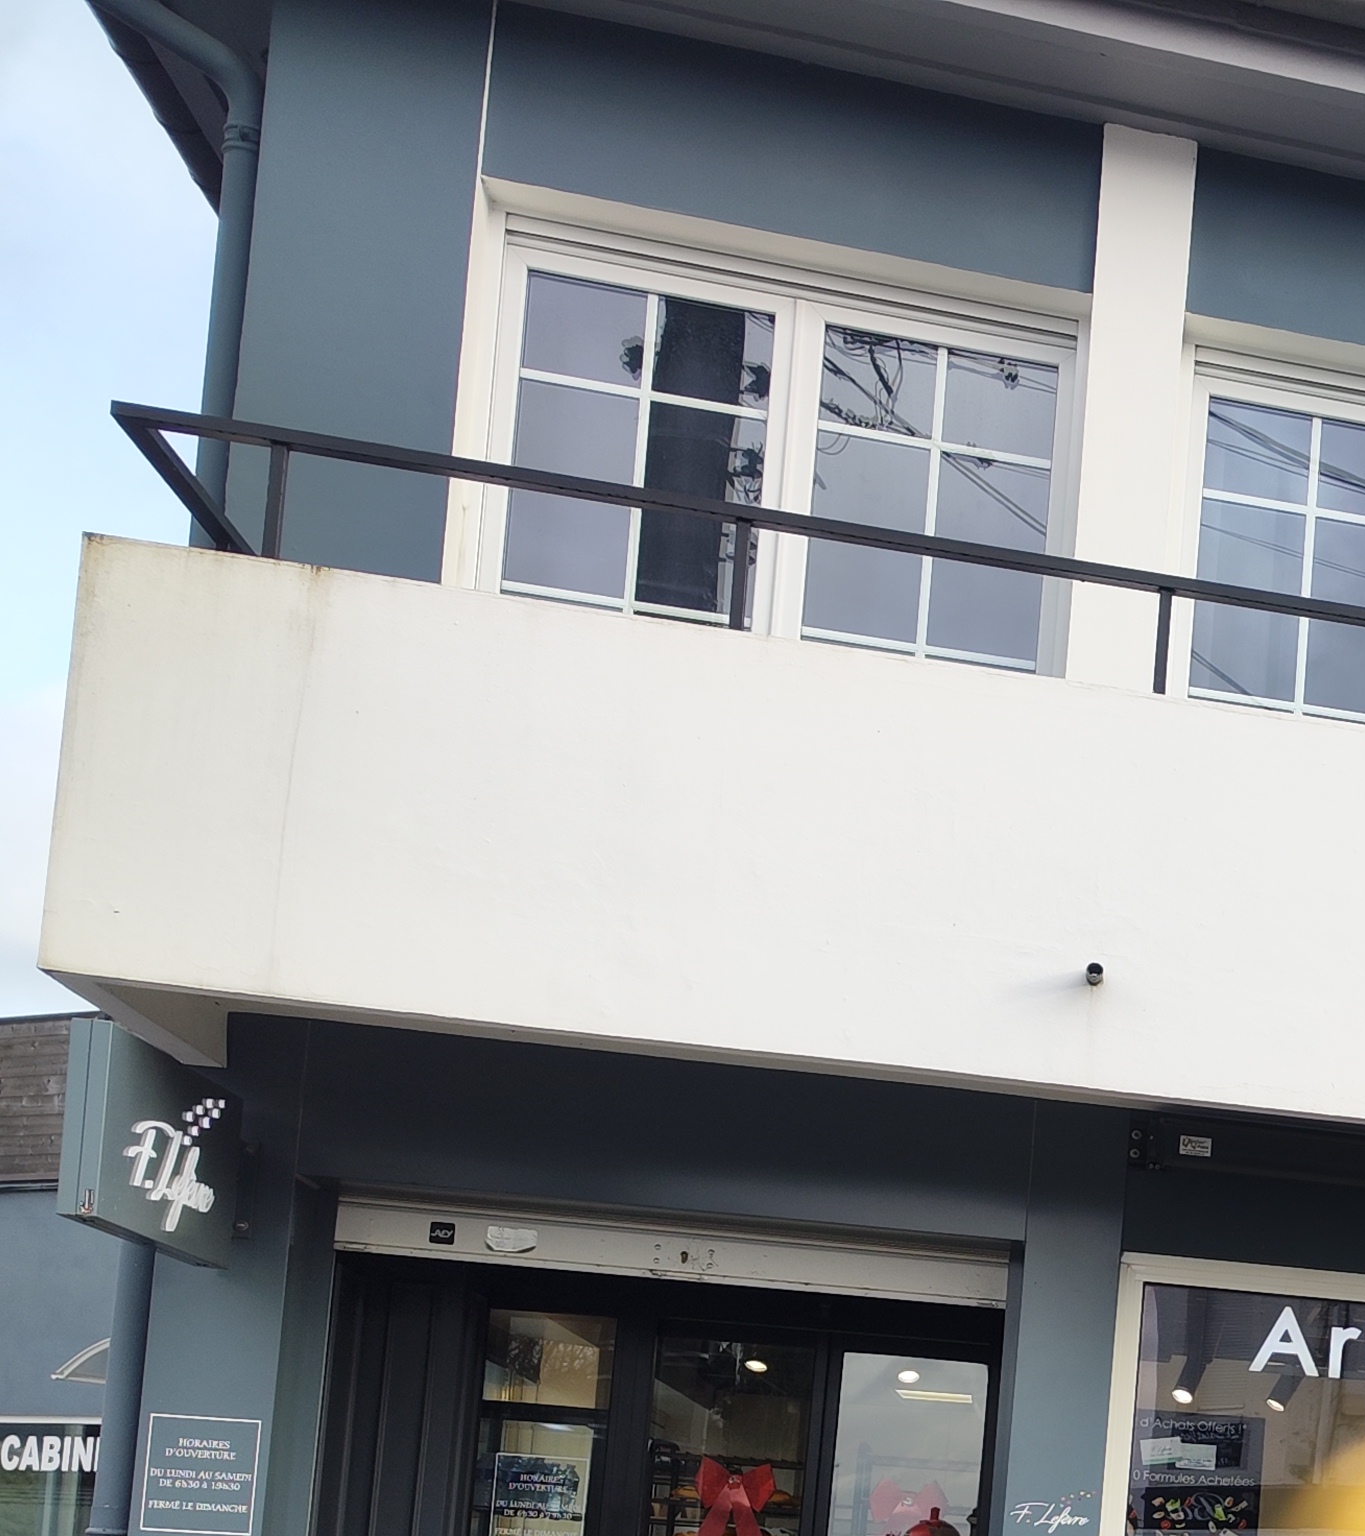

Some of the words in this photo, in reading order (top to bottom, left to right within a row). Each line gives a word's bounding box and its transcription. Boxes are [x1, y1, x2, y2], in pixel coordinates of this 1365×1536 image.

[1140, 1418, 1195, 1432] d'Achats
[1197, 1421, 1235, 1434] Offerts
[179, 1438, 231, 1449] HORAIRES
[165, 1448, 237, 1460] D'OUVERTURE
[150, 1468, 164, 1477] DU
[166, 1469, 196, 1478] LUNDI
[197, 1470, 213, 1480] AU
[214, 1472, 252, 1481] SAMEDI
[1143, 1470, 1195, 1484] Formules
[1196, 1475, 1256, 1487] Achetées
[159, 1479, 172, 1487] DE
[148, 1500, 180, 1509] FERMÉ
[182, 1502, 194, 1510] LE
[196, 1502, 248, 1513] DIMANCHE
[1010, 1502, 1050, 1524] F.
